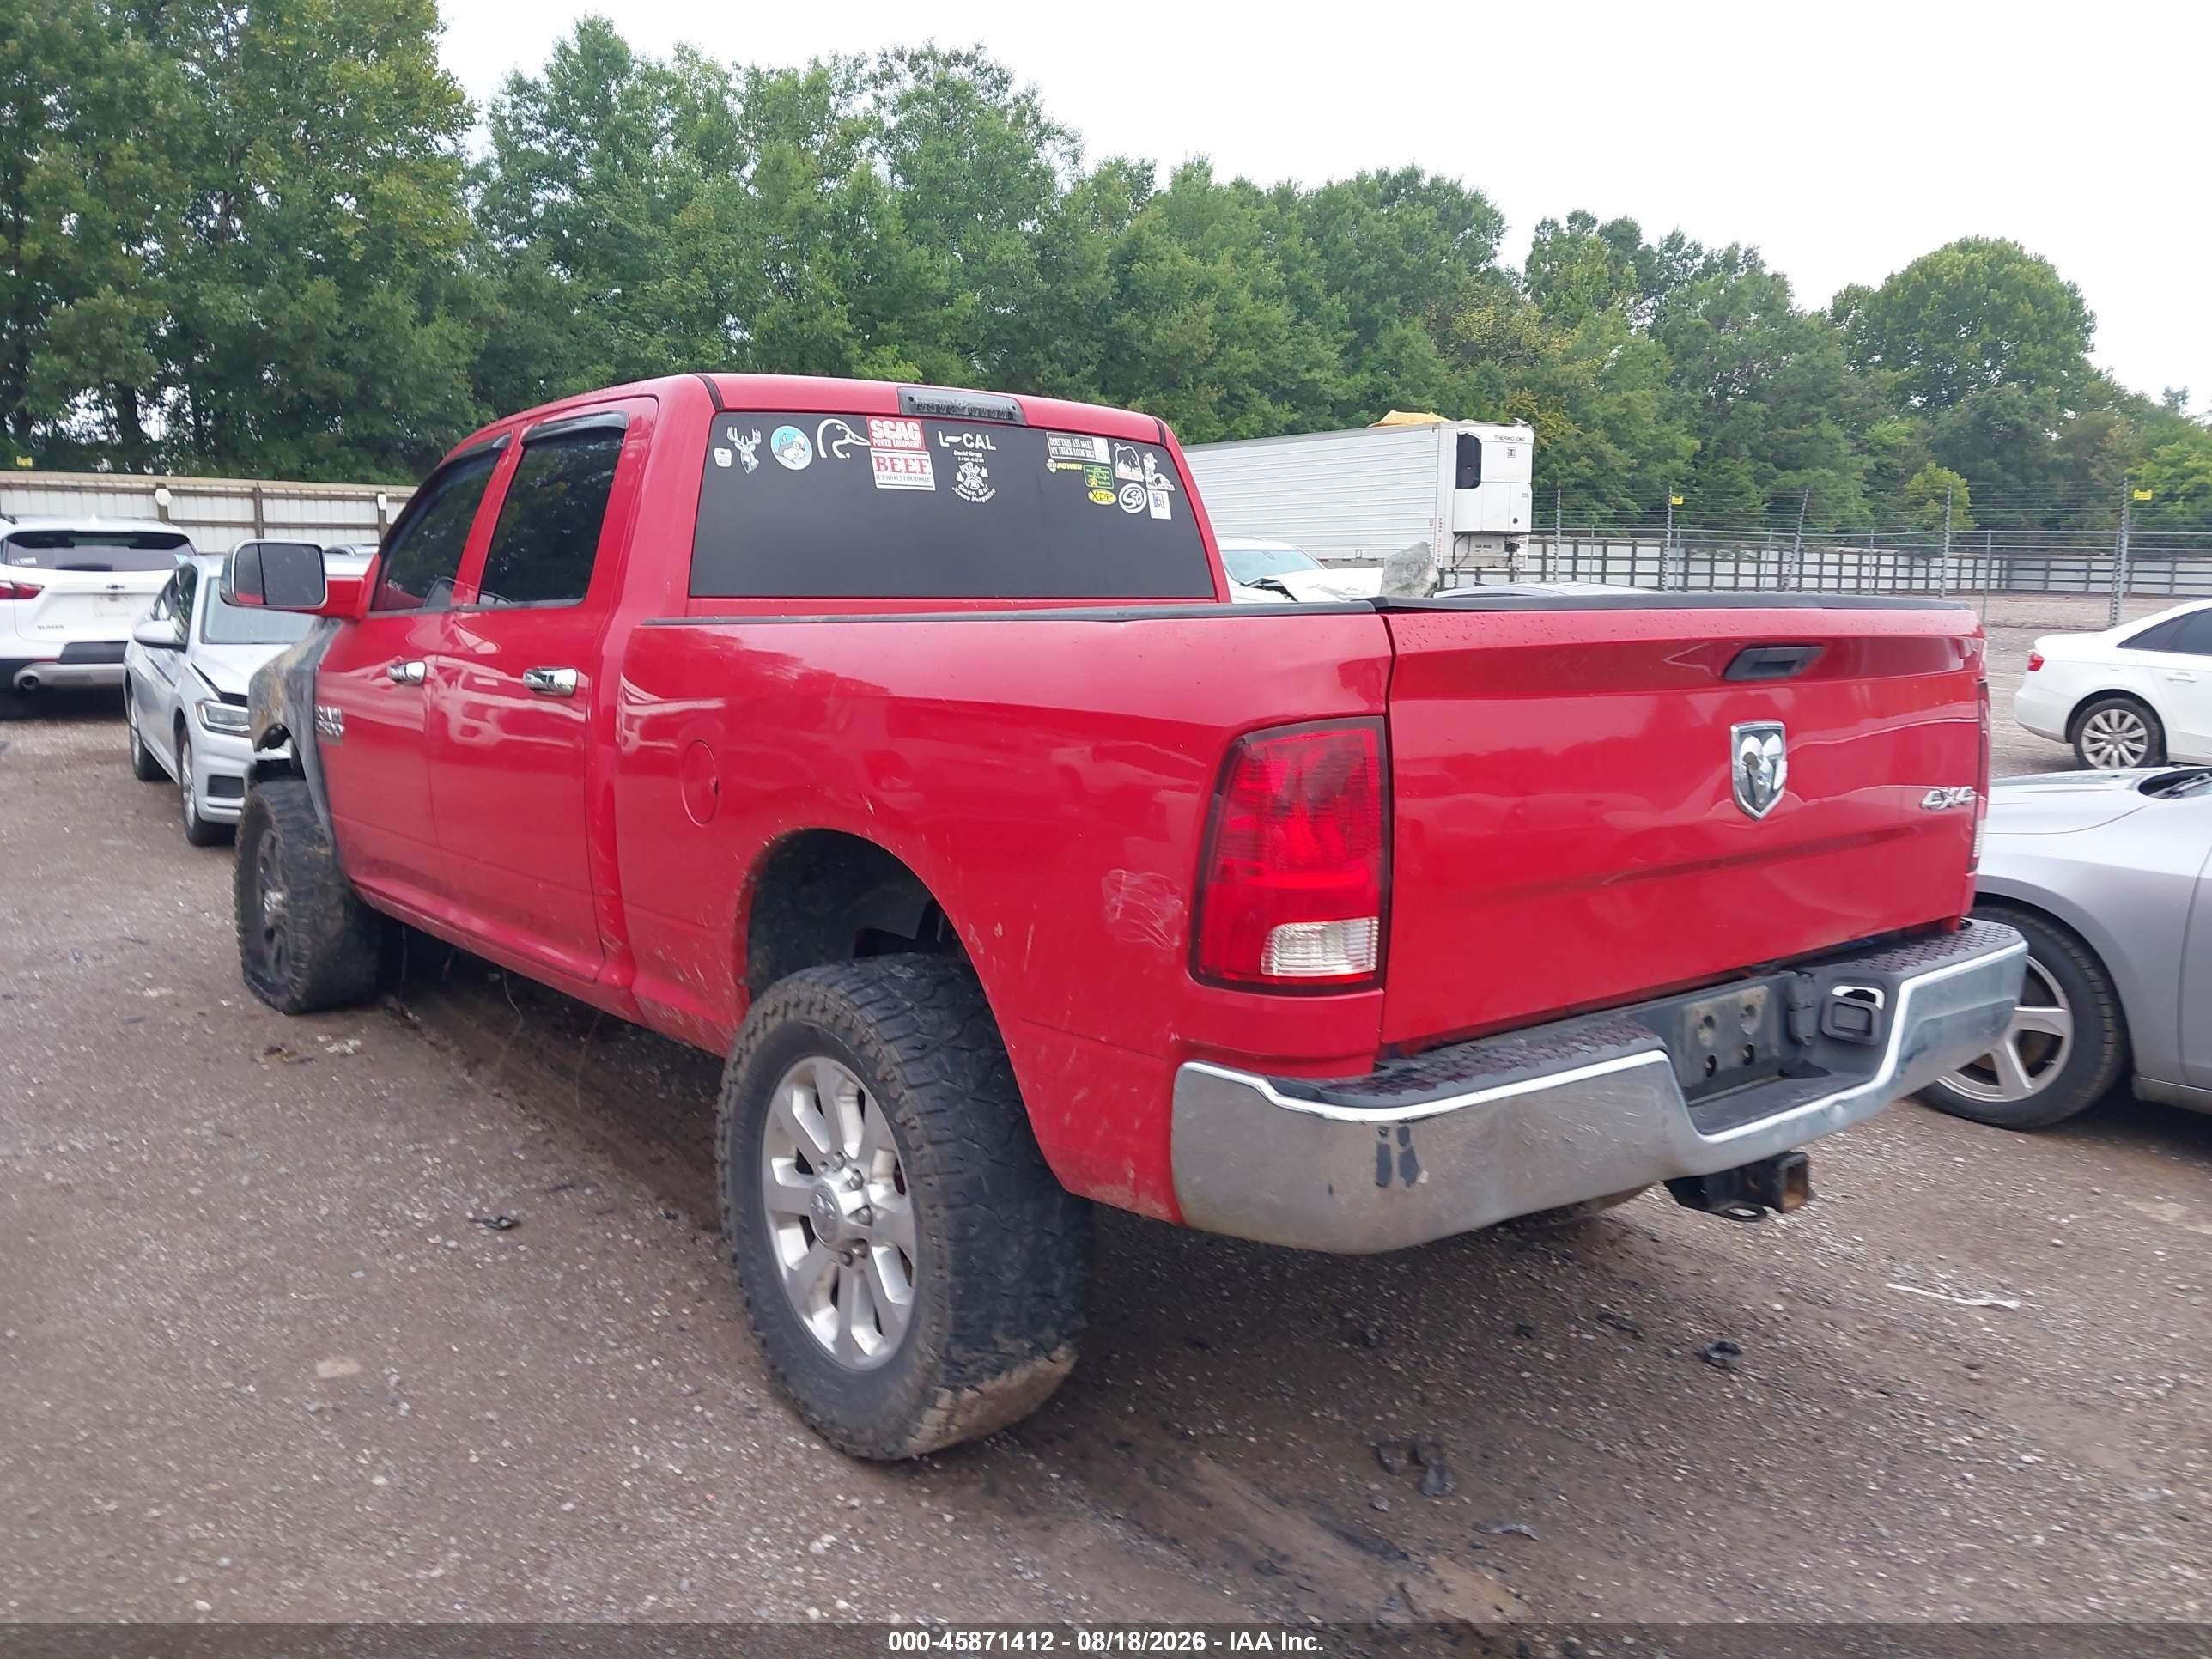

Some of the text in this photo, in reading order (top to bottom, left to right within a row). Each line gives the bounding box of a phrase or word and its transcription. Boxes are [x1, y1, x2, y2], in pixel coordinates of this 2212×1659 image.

[869, 418, 921, 441] SCAG
[1048, 437, 1093, 450] DOES THIS ASS MAKE
[1050, 446, 1059, 454] MY
[1058, 447, 1073, 456] TRUCK
[1073, 447, 1085, 458] LOOK
